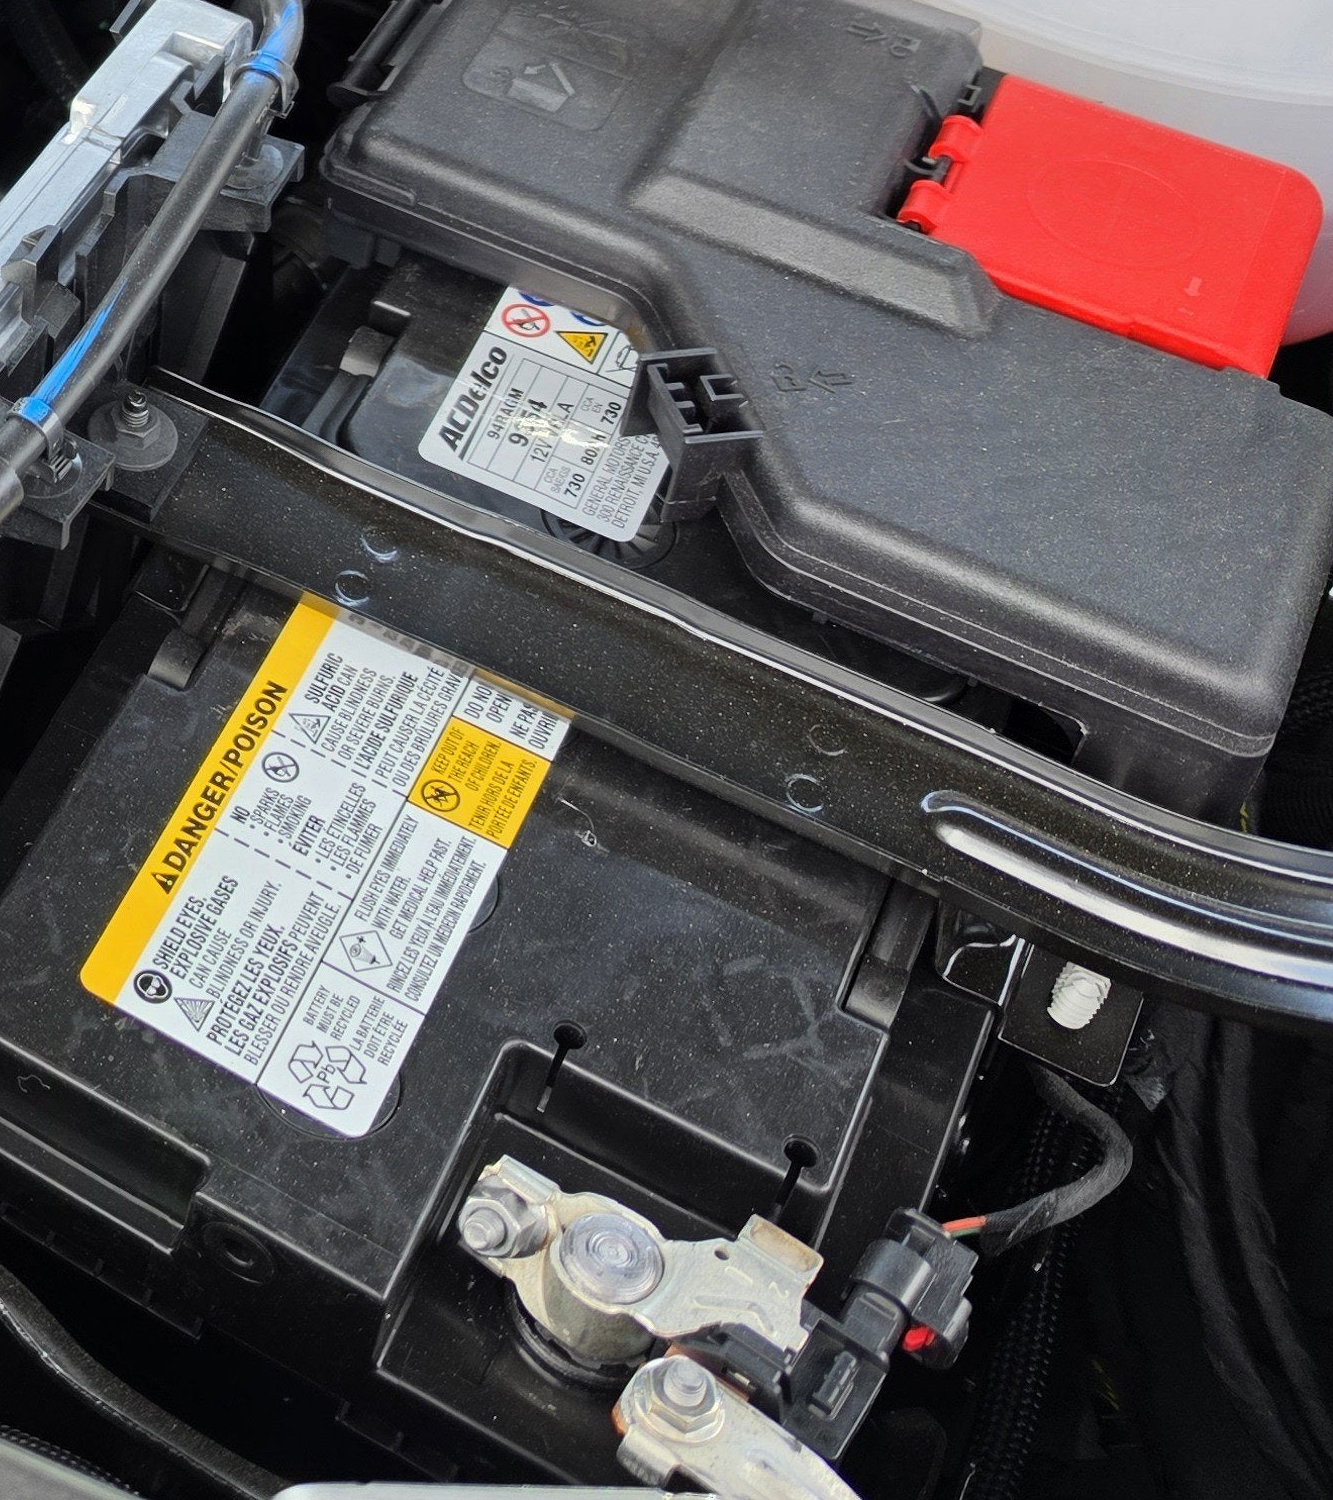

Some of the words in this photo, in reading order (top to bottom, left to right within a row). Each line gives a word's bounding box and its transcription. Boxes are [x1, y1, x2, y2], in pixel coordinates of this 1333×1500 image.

[440, 347, 506, 450] ACDelco
[600, 401, 621, 424] 730
[529, 438, 552, 462] 12V
[563, 473, 585, 497] 730
[582, 476, 616, 515] GENERAL
[602, 434, 633, 474] MOTORS
[601, 444, 649, 504] RENAISSANCE
[596, 504, 615, 522] 300
[607, 487, 642, 528] DETROIT,
[630, 473, 647, 487] MI
[304, 653, 342, 703] SULFURIC
[321, 684, 345, 712] ACID
[336, 664, 357, 686] CAN
[320, 719, 348, 751] CAUSE
[338, 667, 376, 721] BLINDNESS
[374, 671, 417, 732] SULFURIQUE
[463, 701, 484, 719] DO
[345, 707, 375, 745] SEVERE
[448, 726, 464, 740] OF
[509, 721, 529, 739] NE
[337, 743, 355, 760] OR
[374, 750, 398, 779] PEUT
[388, 713, 419, 753] CAUSER
[408, 700, 427, 715] LA
[440, 736, 459, 755] OUT
[399, 750, 420, 772] DES
[430, 752, 450, 775] KEEP
[455, 740, 479, 768] REACH
[496, 760, 514, 773] LA
[164, 682, 285, 870] DANGER/POISON
[391, 769, 410, 786] OU
[447, 765, 466, 783] THE
[464, 777, 480, 791] OF
[491, 770, 508, 785] DE
[479, 782, 502, 807] HORS
[500, 794, 518, 809] DE
[230, 806, 250, 823] NO
[467, 805, 490, 829] TENIR
[329, 845, 350, 866] LES
[341, 798, 375, 846] FLAMMES
[353, 823, 382, 859] FUMER
[315, 837, 335, 858] LES
[345, 857, 363, 874] DE
[354, 890, 379, 921] FLUSH
[368, 869, 390, 893] EYES
[380, 814, 417, 871] IMMEDIATELY
[388, 918, 408, 939] GET
[398, 884, 427, 921] MEDICAL
[417, 859, 438, 884] HELP
[169, 913, 216, 978] EXPLOSIVE
[206, 875, 238, 915] GASES
[371, 904, 394, 929] WITH
[152, 927, 186, 969] SHIELD
[408, 924, 430, 947] YEUX
[188, 963, 211, 988] CAN
[202, 927, 231, 965] CAUSE
[206, 937, 248, 998] BLINDNESS
[239, 920, 258, 938] OR
[400, 946, 419, 964] LES
[224, 1029, 249, 1056] LES
[238, 1002, 263, 1030] GAZ
[252, 939, 297, 1005] EXPLOSIFS
[288, 891, 323, 942] PEUVENT
[240, 957, 264, 983] LES
[279, 951, 313, 997] RENDRE
[386, 960, 412, 992] RINCEZ
[404, 954, 437, 1001] CONSULTEZ
[426, 941, 444, 957] UN
[270, 994, 289, 1014] OU
[302, 984, 329, 1025] BATTERY
[316, 1005, 336, 1033] MUST
[329, 993, 343, 1007] BE
[355, 995, 384, 1038] BATTERIE
[330, 995, 360, 1040] RECYCLED
[243, 1013, 280, 1065] BLESSER
[348, 1037, 364, 1051] LA
[363, 1034, 381, 1058] DOIT
[316, 1063, 338, 1083] Pb
